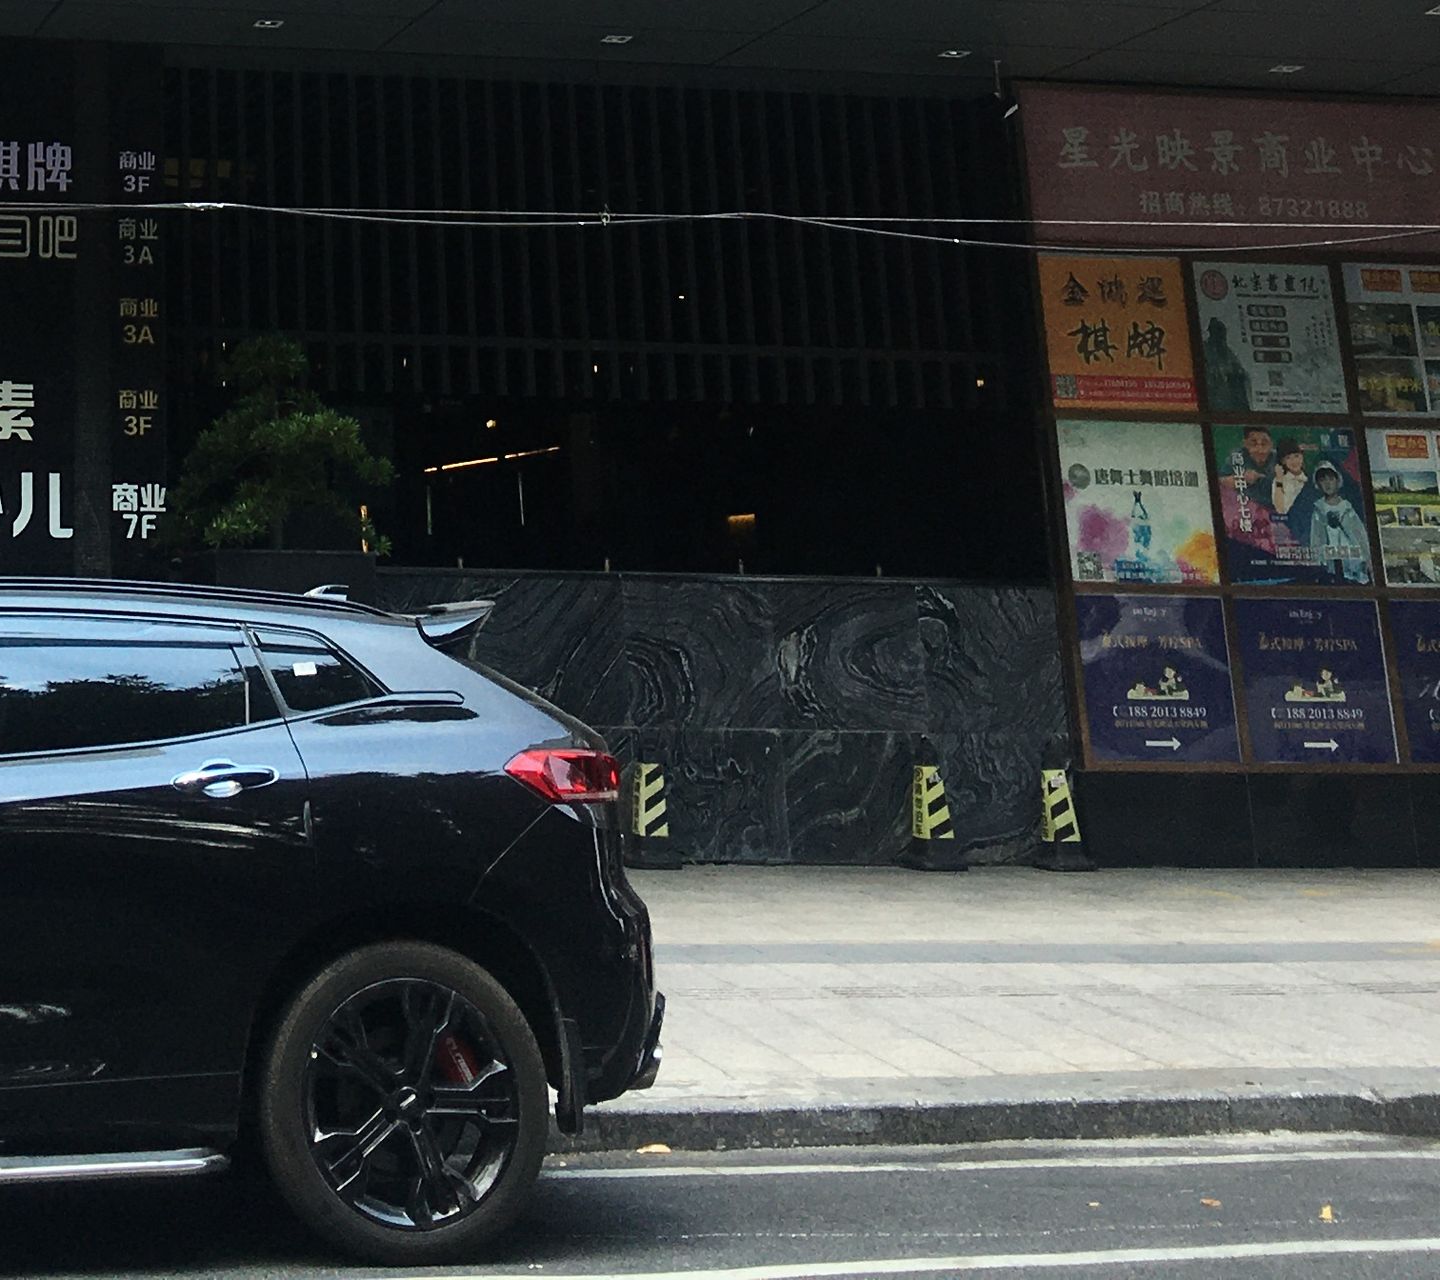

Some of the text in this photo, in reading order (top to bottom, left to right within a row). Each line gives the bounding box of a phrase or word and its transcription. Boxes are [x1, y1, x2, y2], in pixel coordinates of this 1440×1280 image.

[119, 150, 155, 171] 商业
[1058, 126, 1434, 182] 星光映景商业中心
[123, 175, 150, 192] 3F
[118, 218, 158, 240] 商业
[123, 245, 154, 265] 3A
[119, 297, 158, 318] 商业
[123, 324, 154, 344] 3A
[1067, 318, 1167, 371] 棋牌
[119, 389, 158, 410] 商业
[123, 416, 152, 436] 3F
[112, 483, 167, 513] 商业
[123, 514, 157, 539] 7F
[1129, 706, 1207, 718] 188 2013 8849
[1309, 707, 1334, 719] 2013
